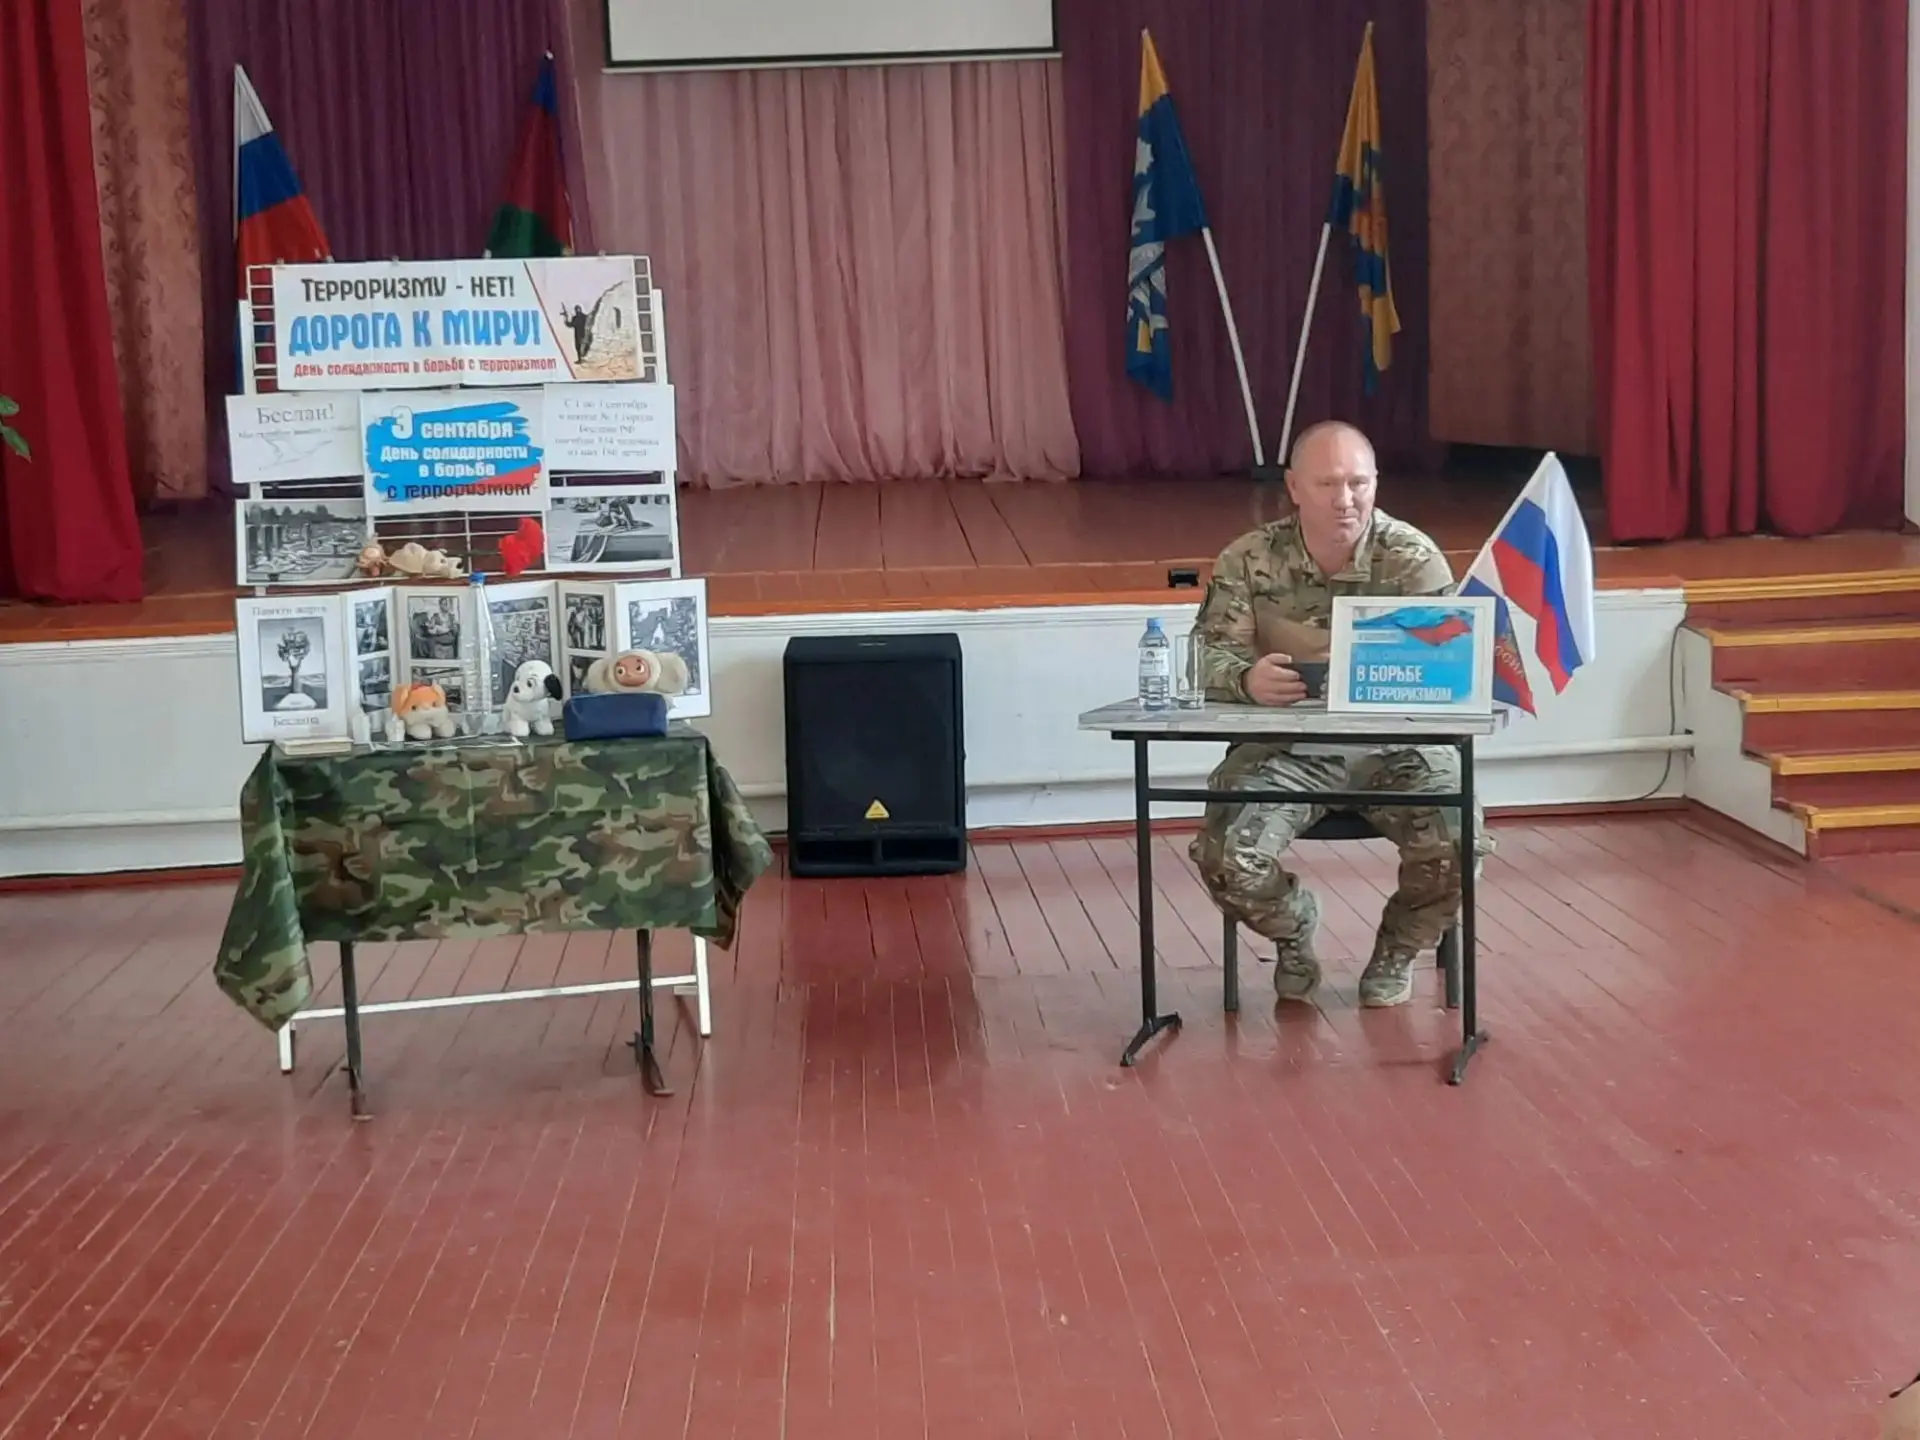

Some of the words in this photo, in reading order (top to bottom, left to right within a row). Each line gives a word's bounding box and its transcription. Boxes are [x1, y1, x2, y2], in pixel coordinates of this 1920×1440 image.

[301, 276, 446, 303] ТЕРРОРИЗМУ
[470, 275, 515, 298] НЕТ!
[289, 312, 402, 357] ДОРОГА
[412, 309, 432, 347] К
[442, 308, 541, 346] МИРУ!
[294, 363, 324, 378] День
[327, 361, 410, 376] солидарности
[424, 357, 465, 373] борьбе
[468, 358, 476, 370] с
[478, 358, 557, 373] терроризмом
[391, 405, 413, 439] 3
[420, 420, 514, 441] сентября
[381, 446, 419, 462] День
[423, 446, 528, 461] солидарности
[419, 463, 429, 477] в
[434, 462, 496, 478] борьбе
[388, 485, 397, 499] с
[404, 484, 531, 499] терроризмом
[1356, 665, 1366, 682] В
[1369, 665, 1424, 682] БОРЬБЕ
[1355, 686, 1363, 701] С
[1366, 686, 1452, 701] ТЕРРОРИЗМОМ
